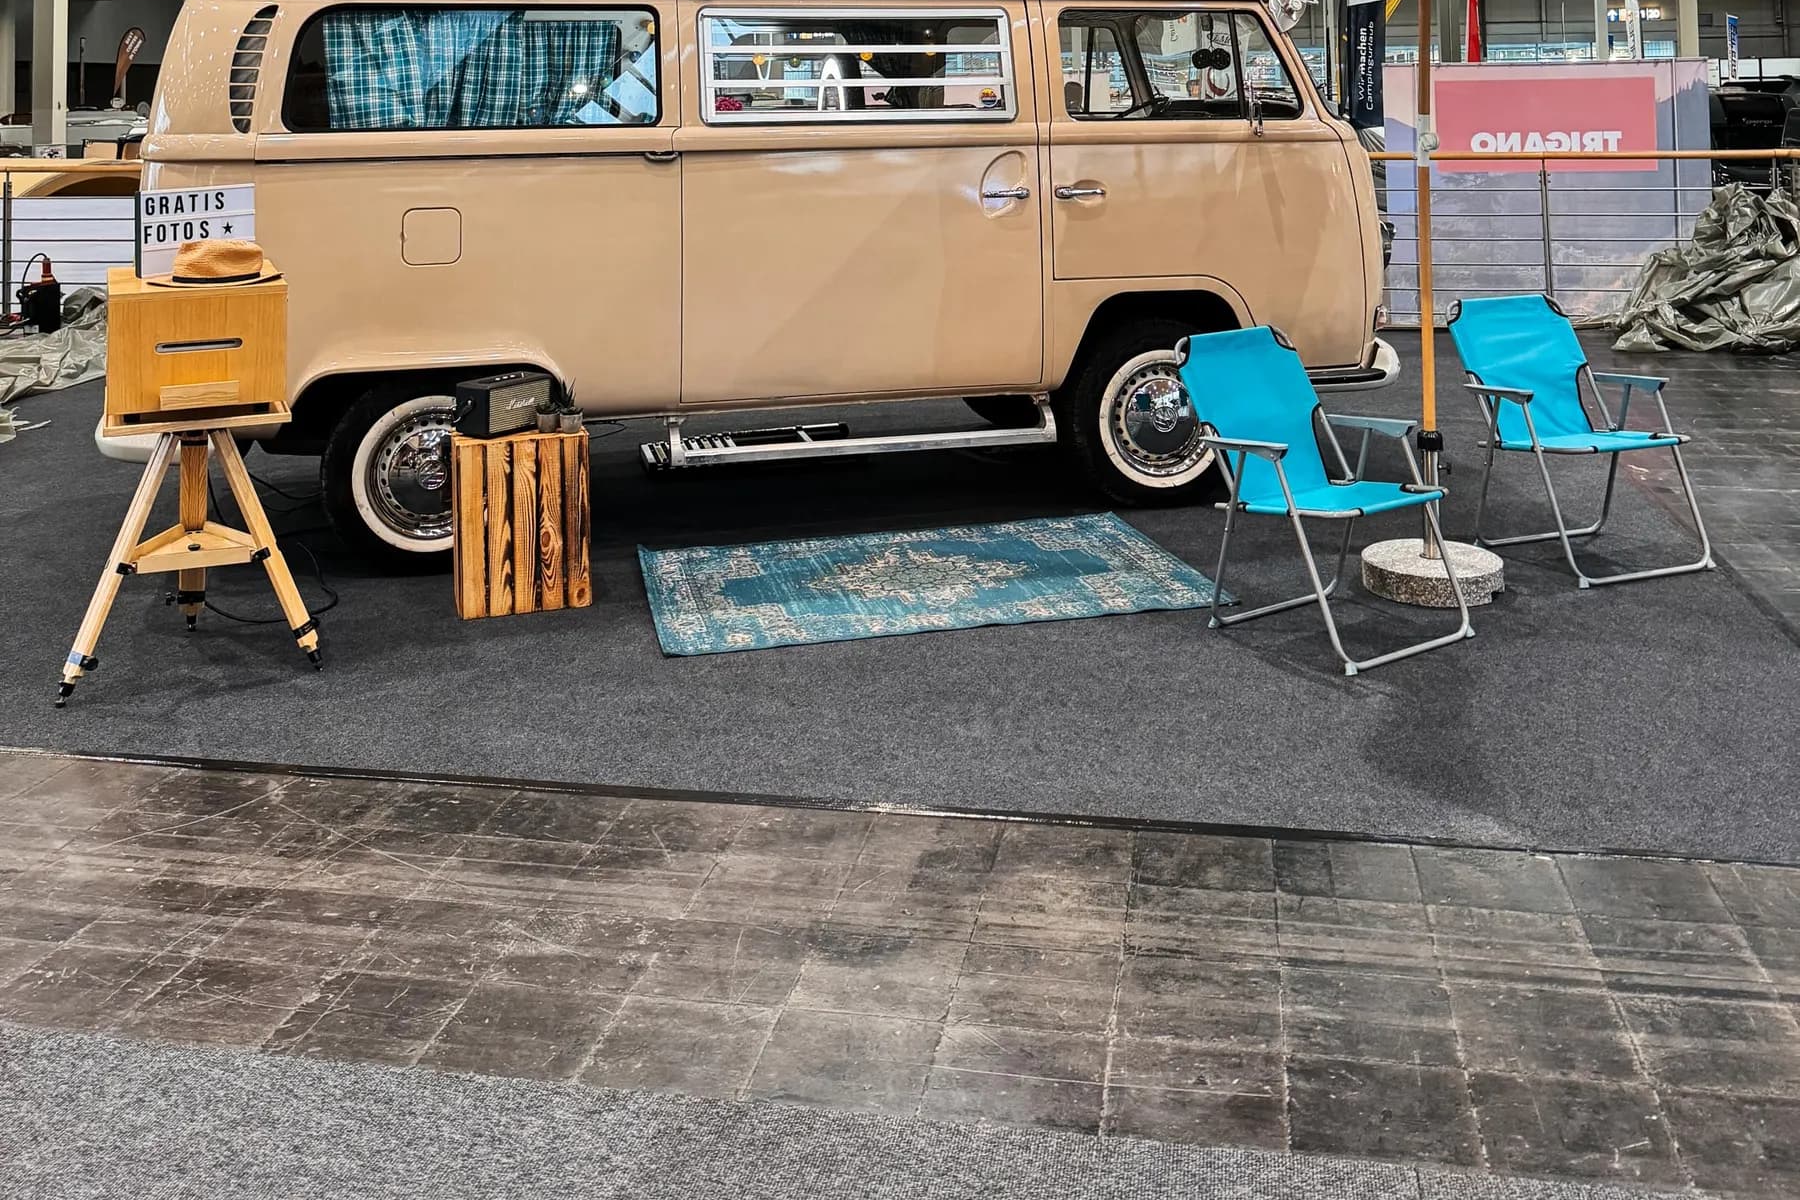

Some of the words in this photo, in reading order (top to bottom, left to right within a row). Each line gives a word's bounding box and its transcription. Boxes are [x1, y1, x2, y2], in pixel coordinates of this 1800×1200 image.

[1357, 26, 1367, 75] machen
[1366, 21, 1374, 111] Campingurlaub
[145, 191, 225, 216] GRATIS
[143, 220, 210, 244] FOTOS
